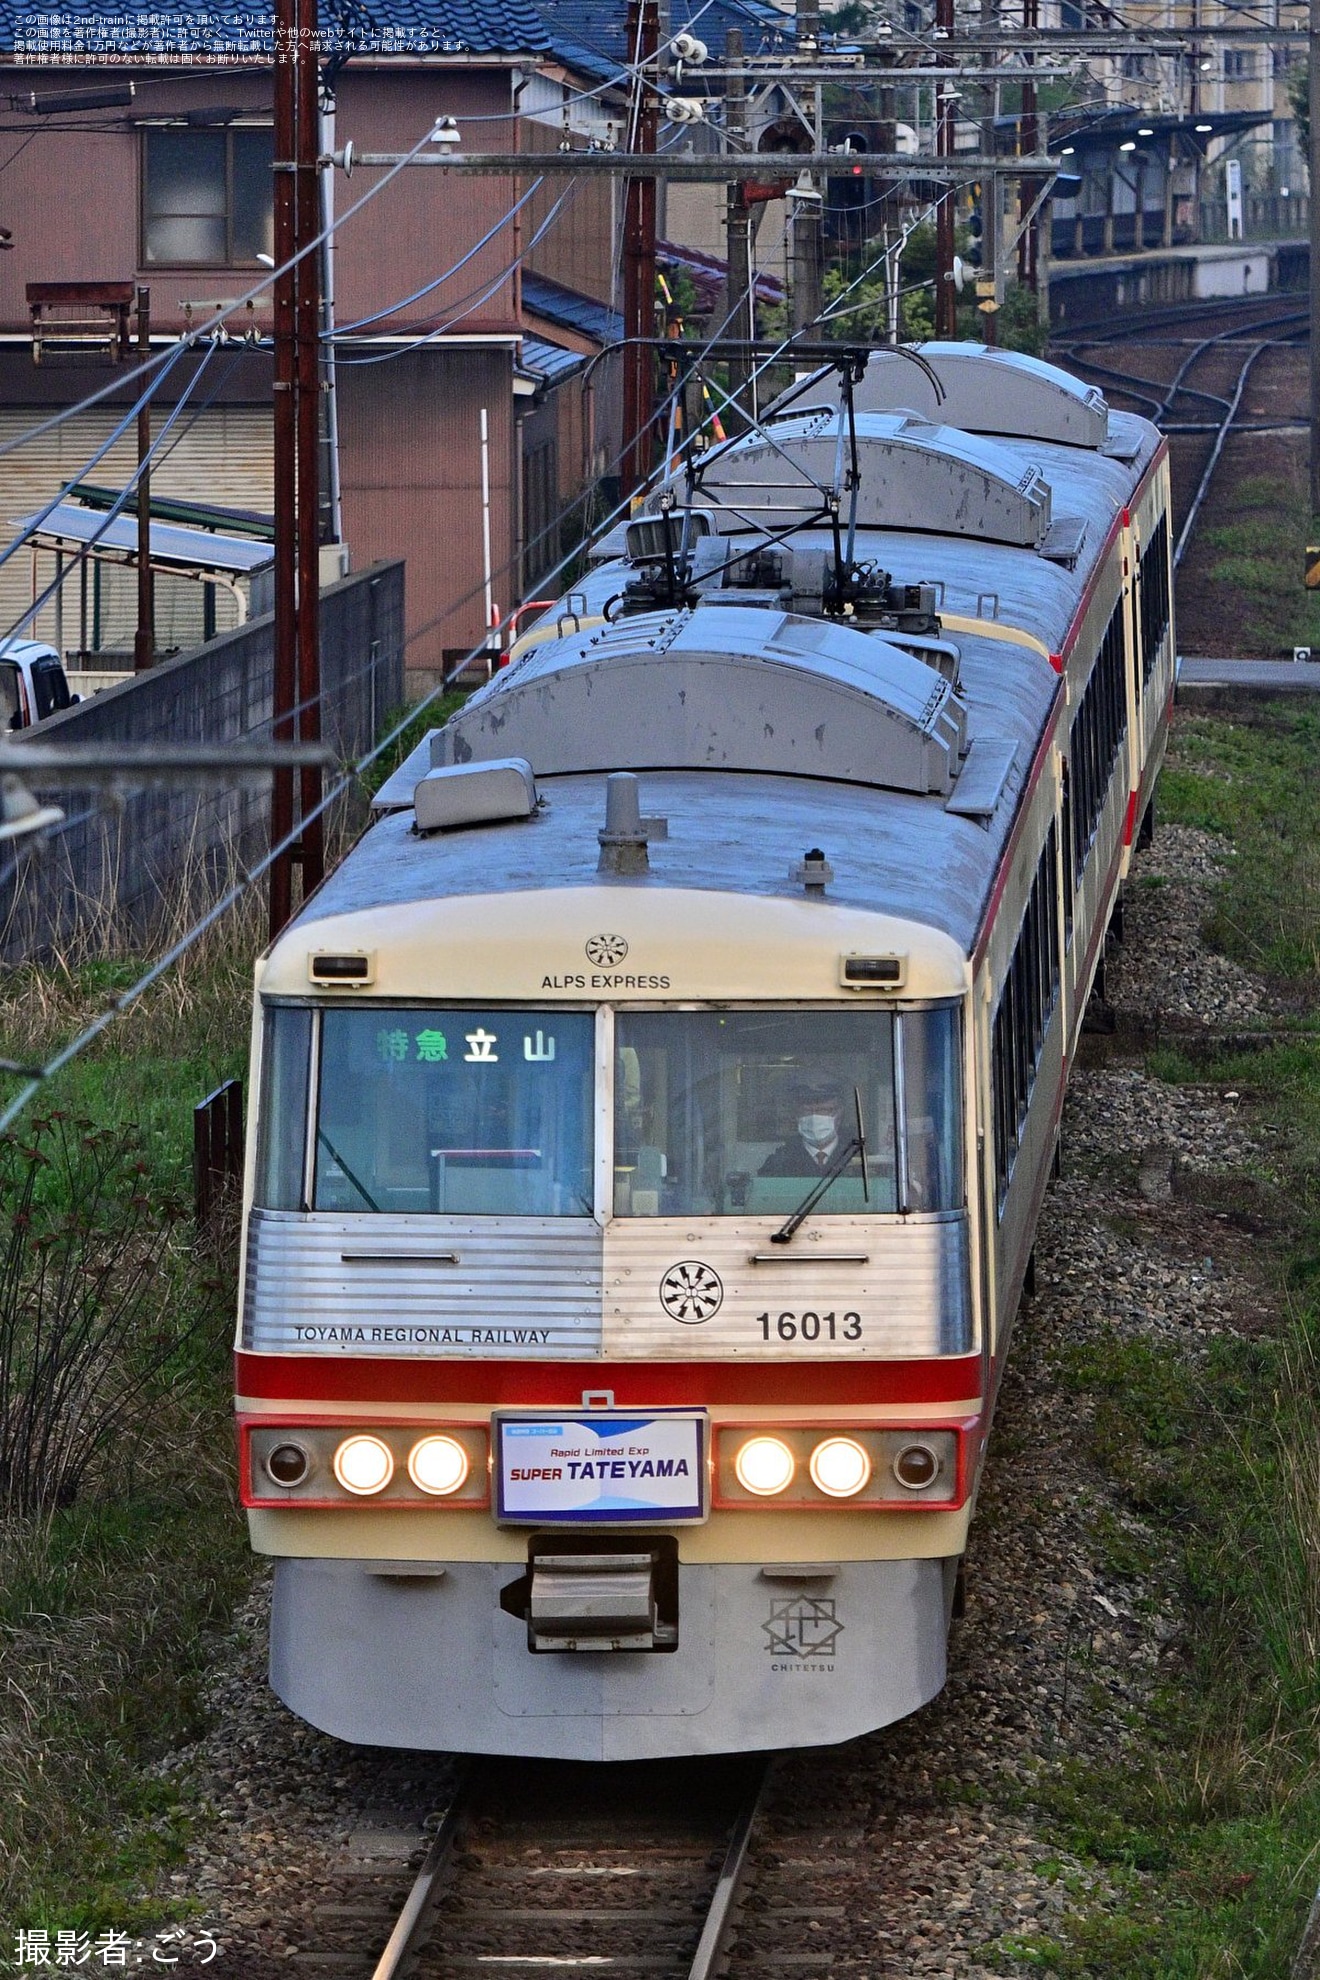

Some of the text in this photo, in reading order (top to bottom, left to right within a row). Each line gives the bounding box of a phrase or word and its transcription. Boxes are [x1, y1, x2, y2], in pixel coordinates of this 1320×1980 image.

[541, 975, 671, 989] ALPS EXPRESS
[756, 1311, 863, 1341] 16013
[294, 1326, 550, 1344] TOYAMA REGIONAL RAILWAY
[550, 1446, 650, 1458] Rapid Limited Exp
[510, 1458, 689, 1481] SUPER TATEYAMA
[771, 1664, 835, 1672] CHITETSU
